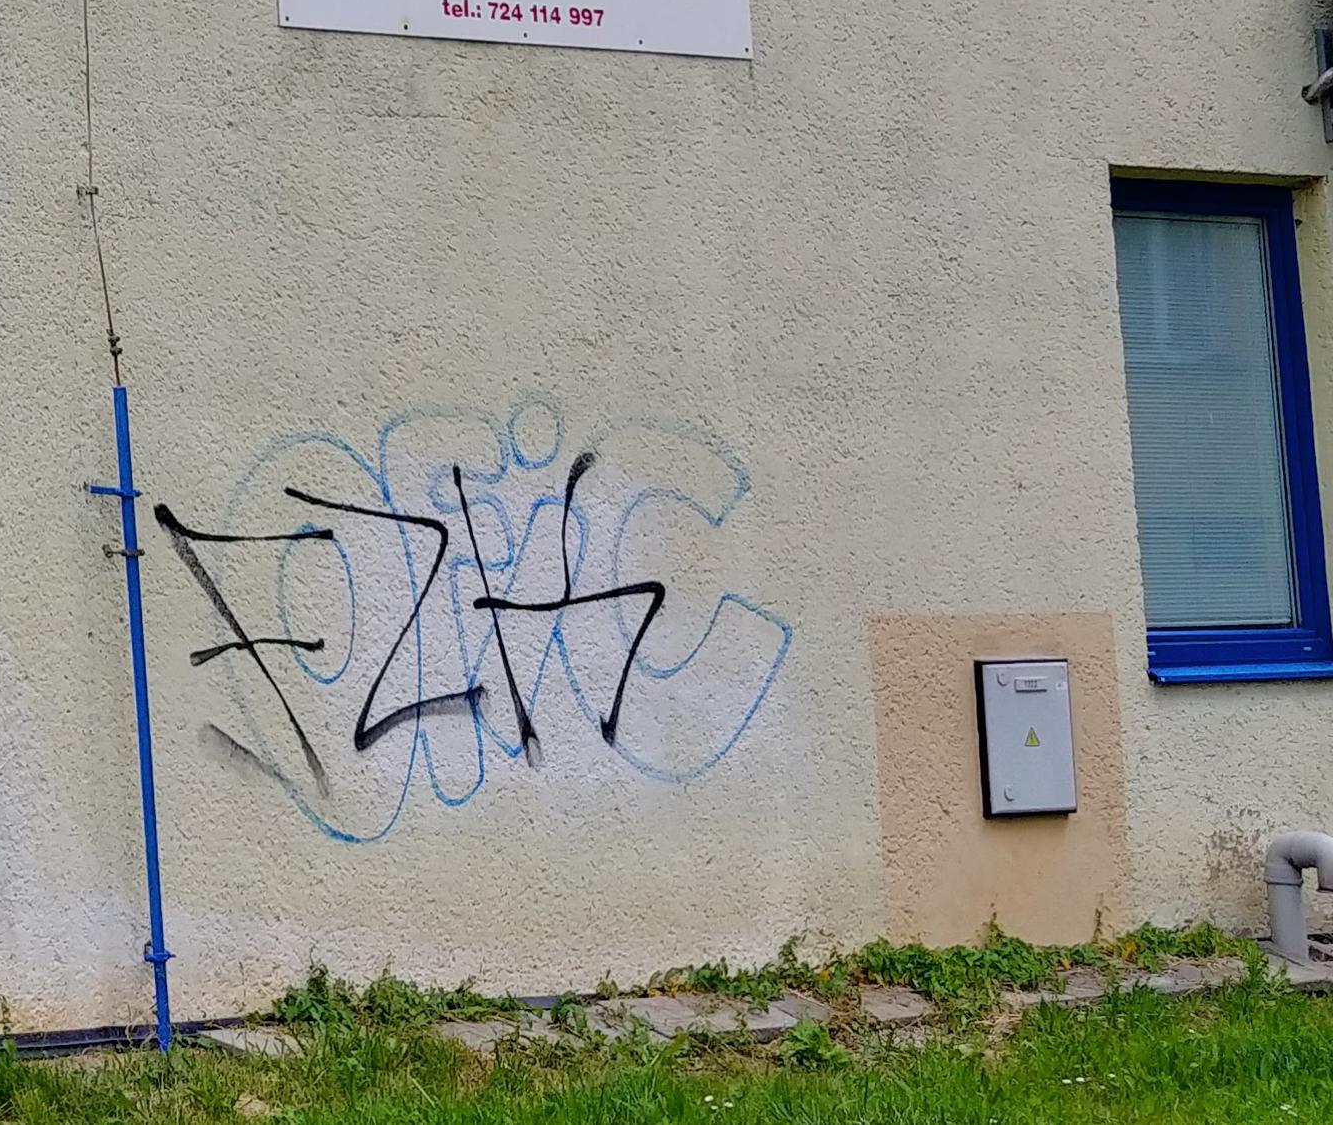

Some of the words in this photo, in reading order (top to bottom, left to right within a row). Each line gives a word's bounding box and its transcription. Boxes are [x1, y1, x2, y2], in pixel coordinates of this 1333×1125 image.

[487, 1, 523, 22] 724
[529, 3, 562, 24] 114
[568, 6, 605, 27] 997
